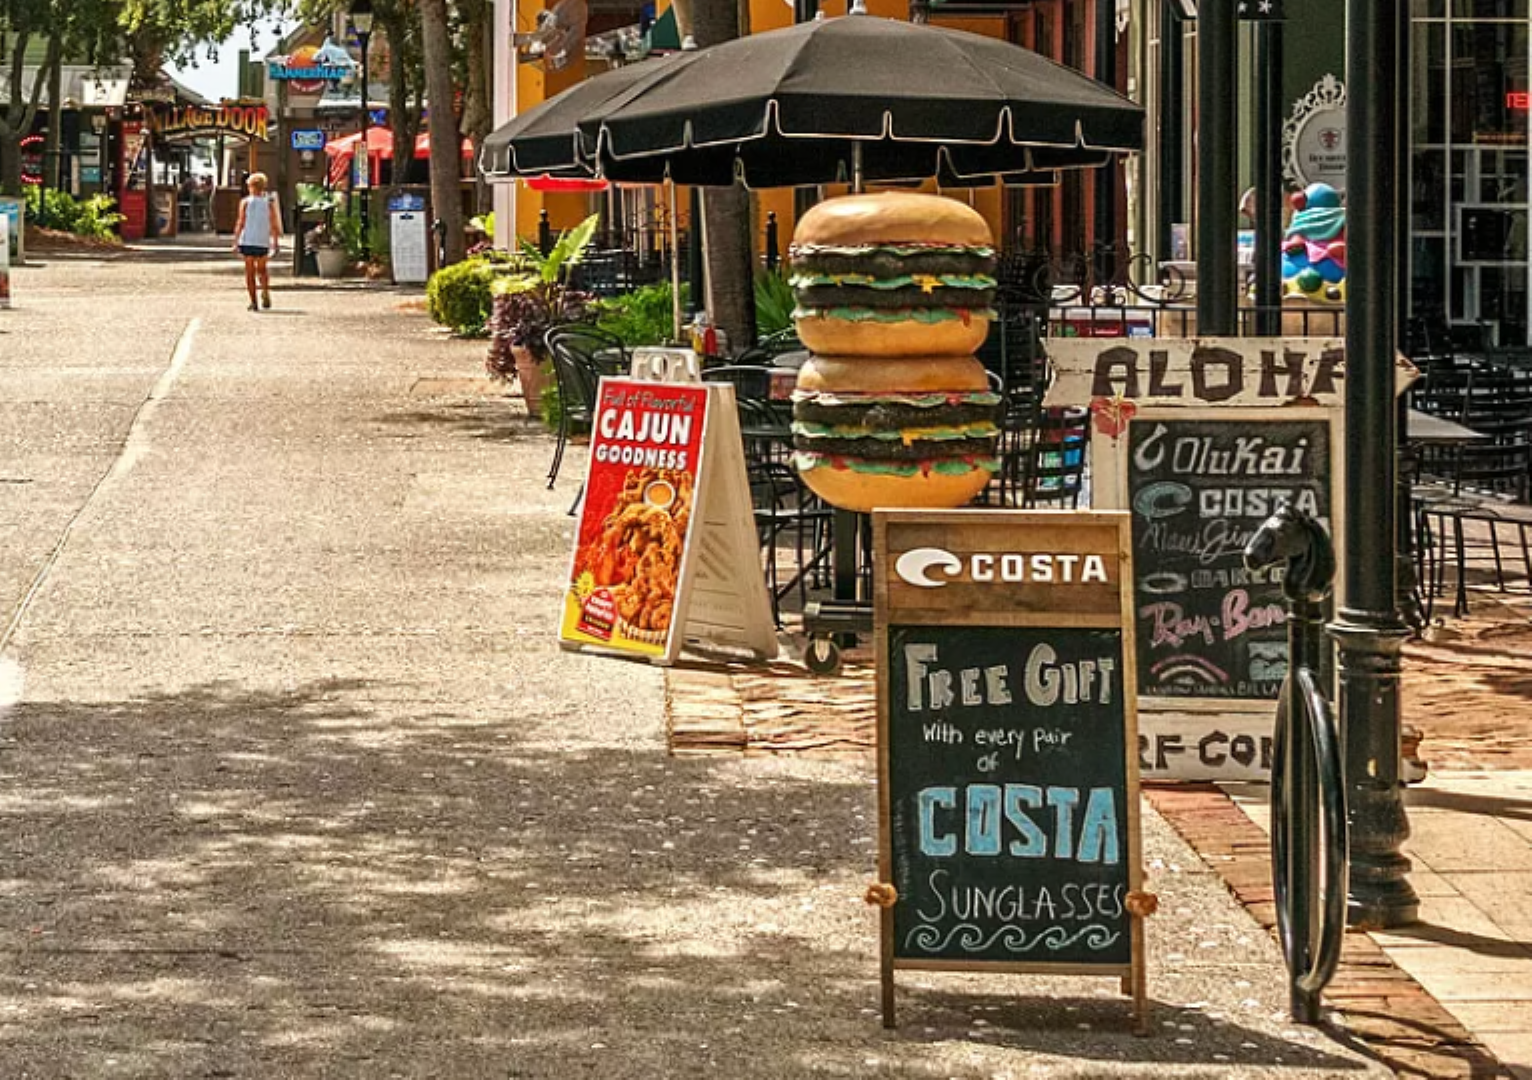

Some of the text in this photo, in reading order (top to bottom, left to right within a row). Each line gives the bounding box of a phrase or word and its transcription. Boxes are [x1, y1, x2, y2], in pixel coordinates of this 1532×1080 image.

[599, 409, 693, 445] CAJUN
[595, 443, 688, 470] GOODNESS
[1172, 437, 1308, 475] OluKai
[1199, 488, 1318, 519] COSTA
[970, 553, 1108, 583] COSTA
[904, 642, 1116, 712] FREE GIFT
[974, 728, 1025, 761] every
[976, 751, 1001, 773] of
[918, 782, 1120, 865] COSTA
[917, 868, 1125, 923] SUNGLASSES
